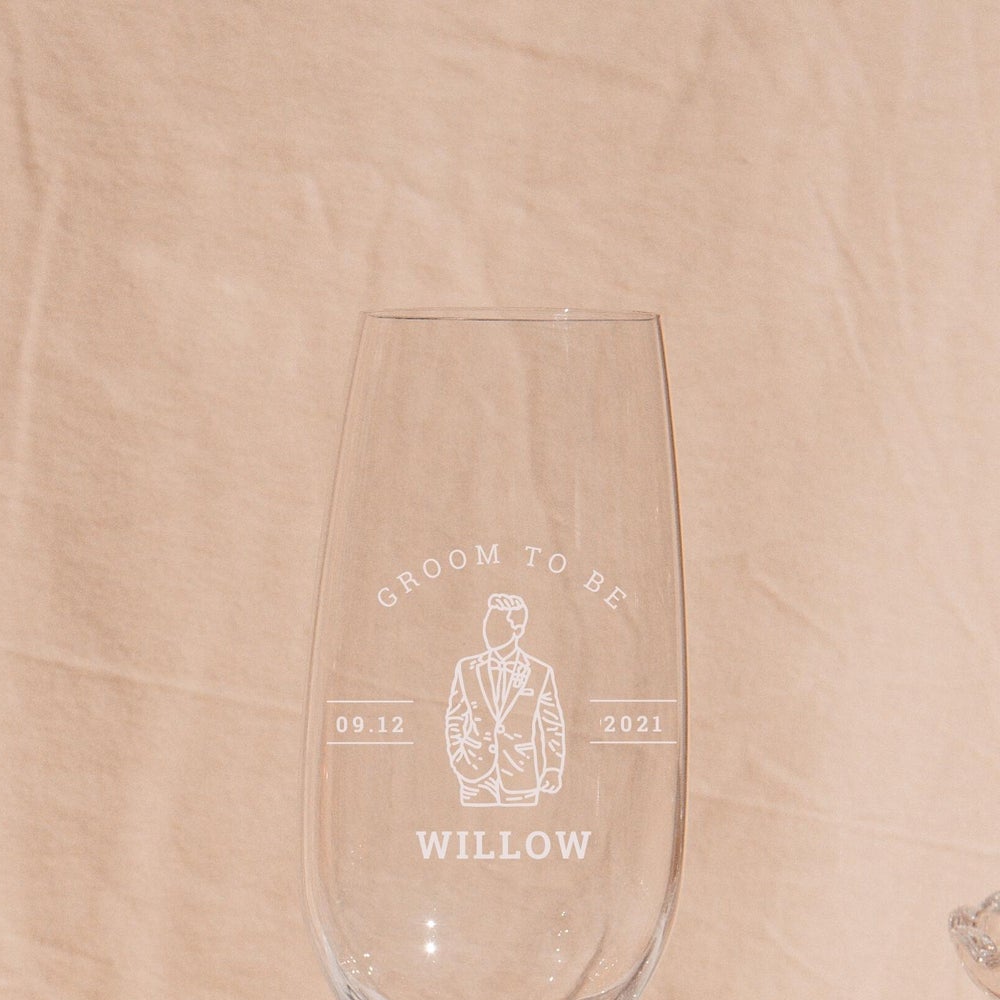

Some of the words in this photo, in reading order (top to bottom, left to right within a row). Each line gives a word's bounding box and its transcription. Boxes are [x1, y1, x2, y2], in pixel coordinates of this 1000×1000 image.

[377, 543, 500, 608] GROOM
[524, 545, 567, 574] TO
[582, 569, 628, 610] BE
[336, 715, 404, 733] 09.12
[603, 715, 663, 733] 2021
[415, 830, 592, 860] WILLOW
